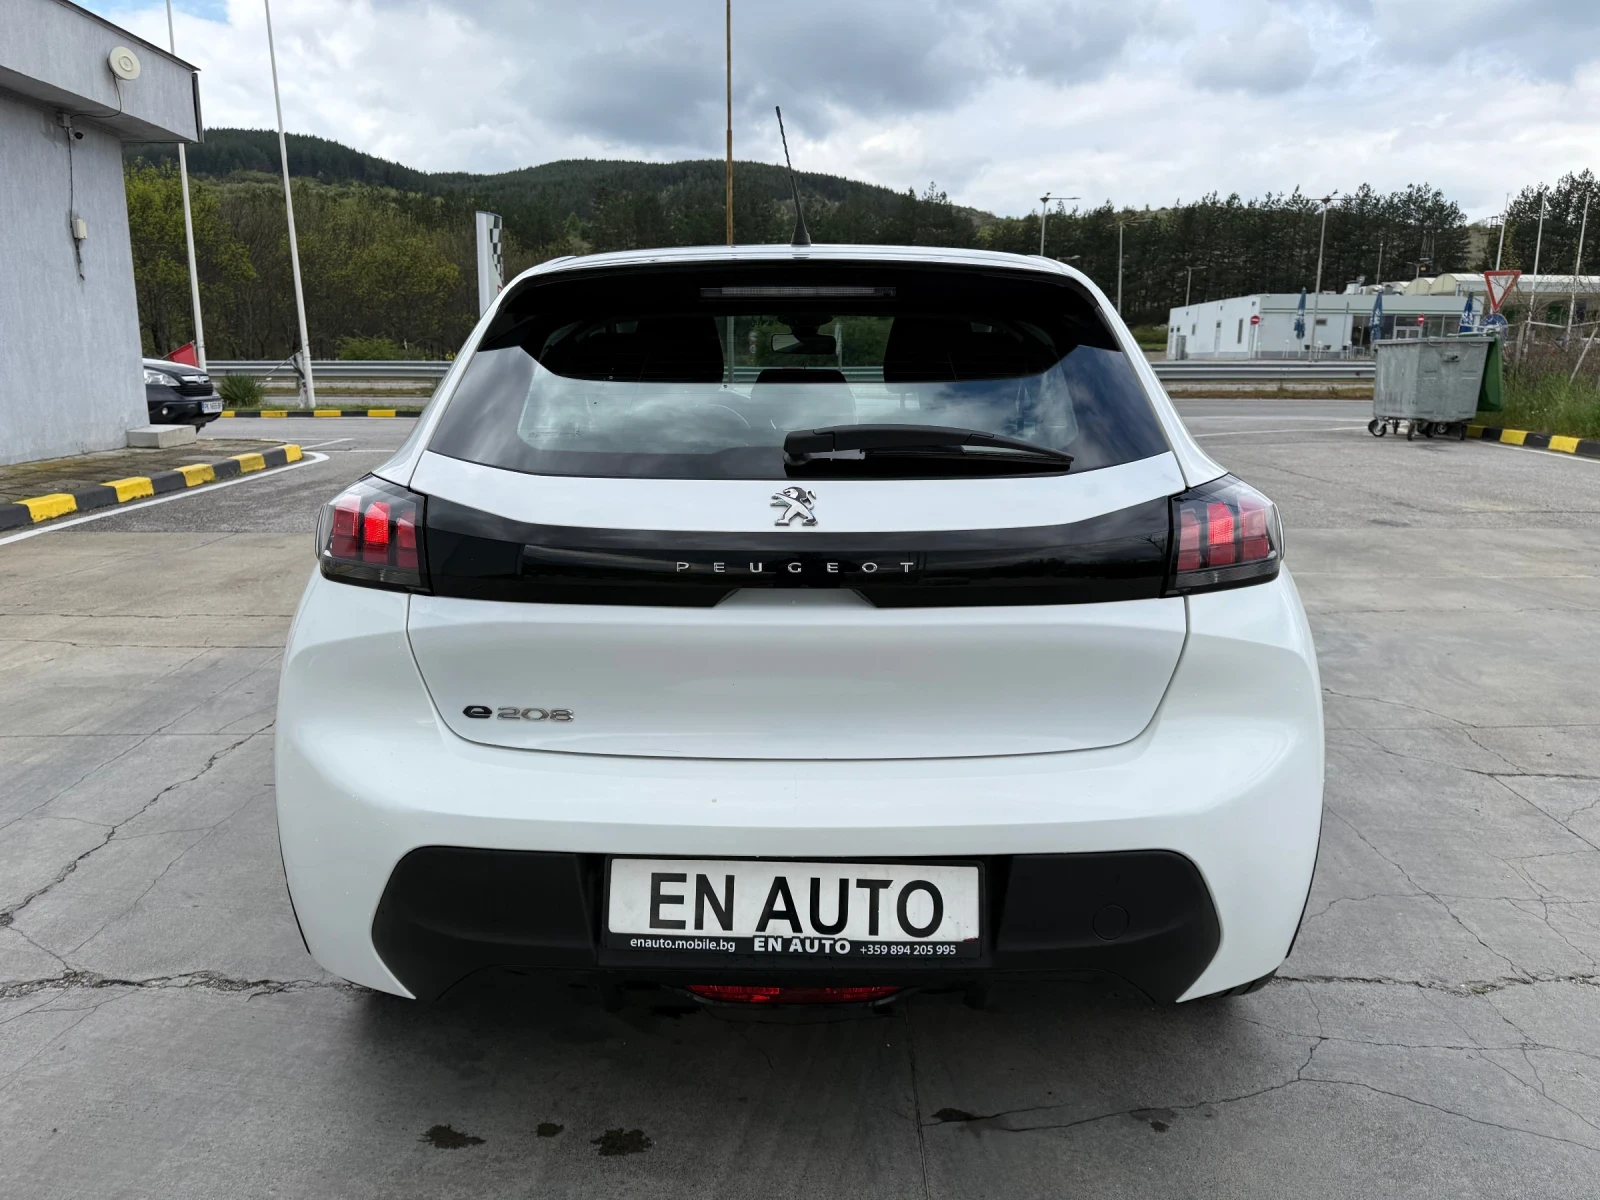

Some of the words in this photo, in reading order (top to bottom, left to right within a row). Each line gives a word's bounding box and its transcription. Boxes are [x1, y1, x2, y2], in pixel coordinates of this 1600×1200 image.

[676, 562, 914, 573] PEUGEOT
[649, 872, 735, 932] EN
[755, 876, 944, 938] AUTO
[630, 937, 736, 952] enauto.mobile.bg
[753, 937, 783, 952] EN
[789, 939, 851, 955] AUTO
[860, 945, 888, 955] +359
[890, 945, 911, 955] 894
[913, 945, 934, 955] 205
[936, 945, 957, 956] 995
